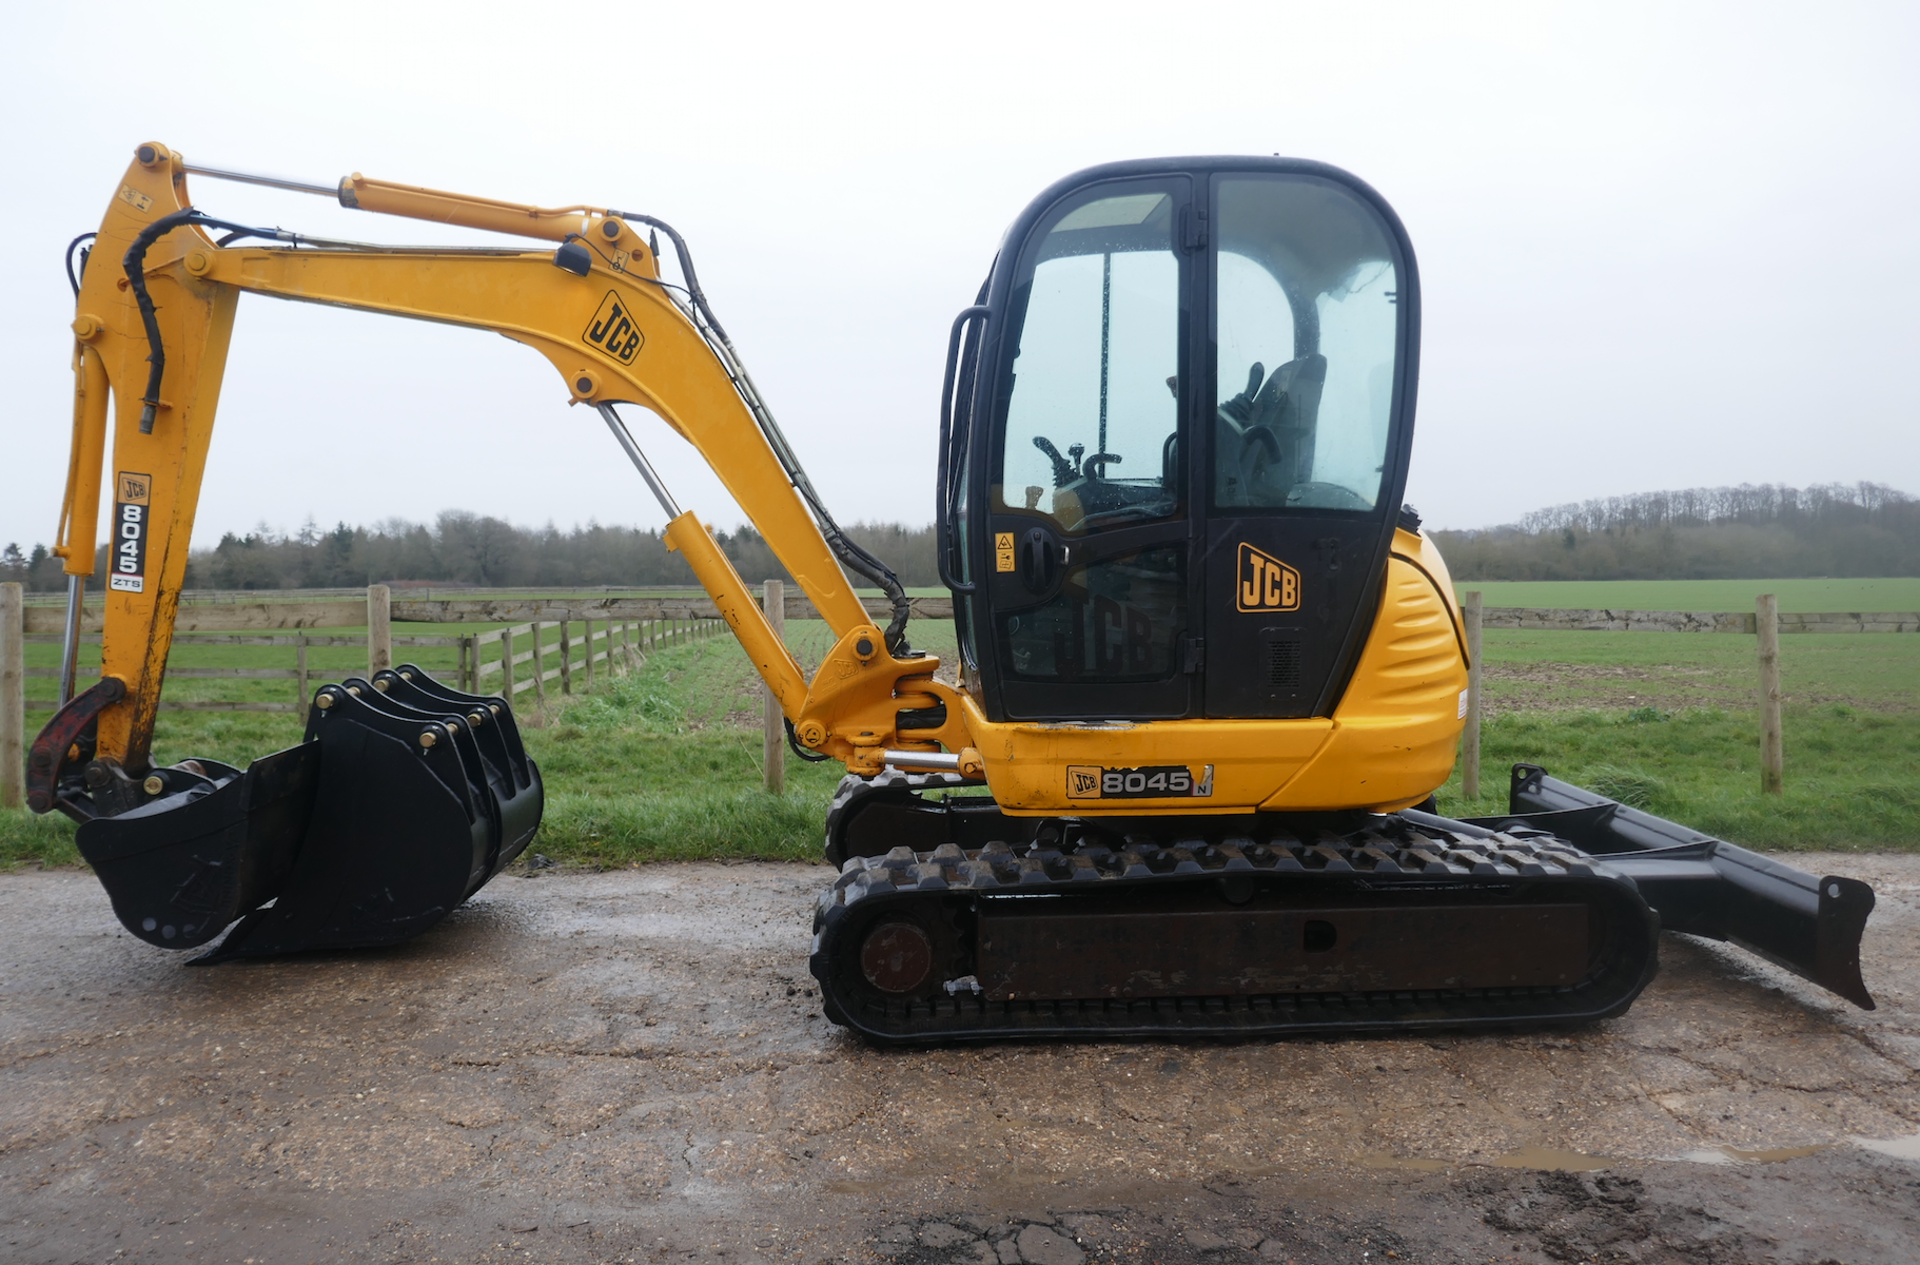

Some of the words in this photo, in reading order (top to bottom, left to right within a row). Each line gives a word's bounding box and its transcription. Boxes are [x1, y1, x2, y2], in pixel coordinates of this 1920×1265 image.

[589, 302, 640, 360] JCB
[126, 480, 145, 498] JCB
[119, 505, 142, 573] 8045
[113, 579, 141, 588] ZTS
[1243, 553, 1296, 606] JCB
[1053, 582, 1153, 676] JCB
[1076, 774, 1098, 793] JCB
[1102, 772, 1190, 793] 8045
